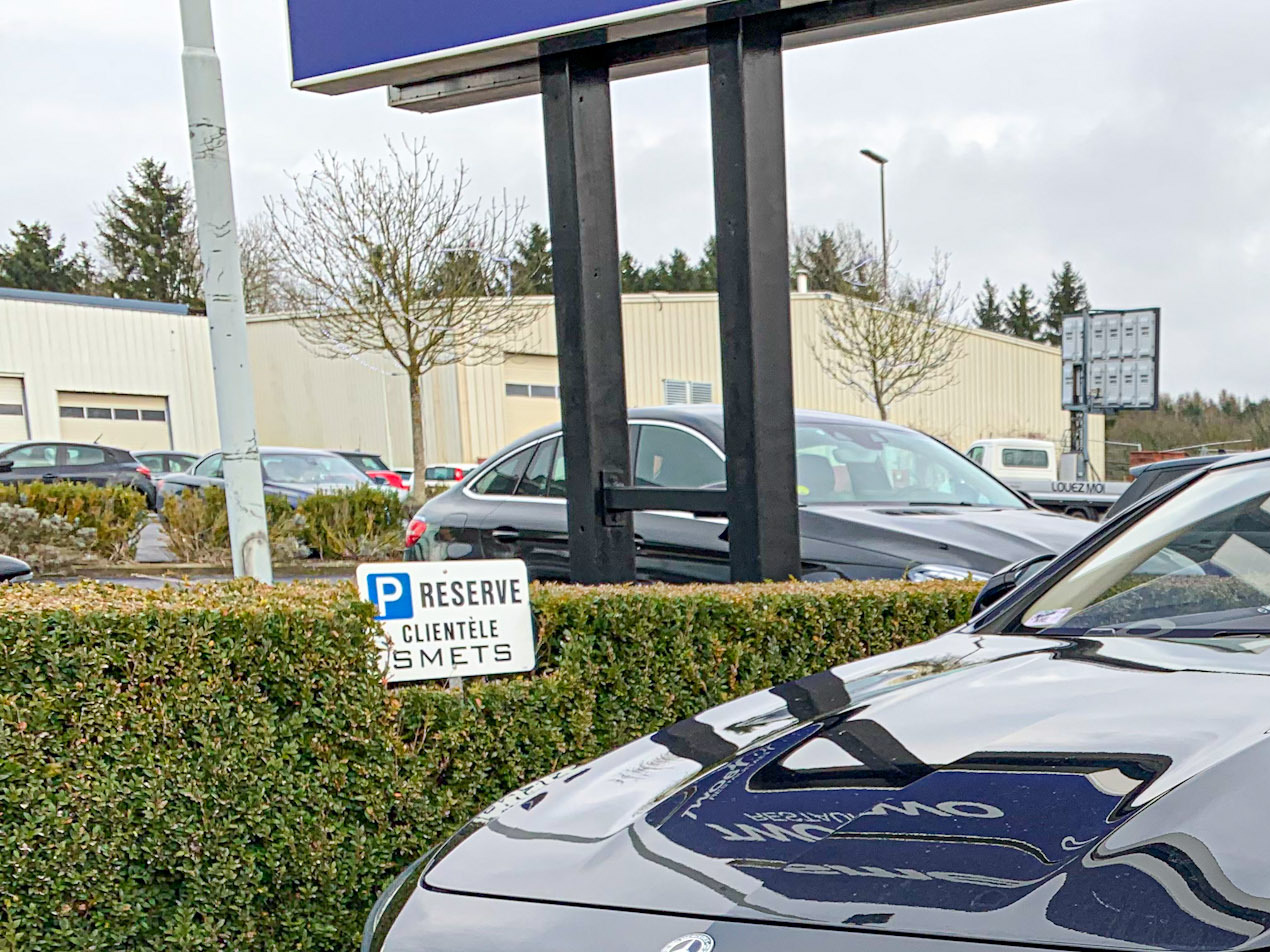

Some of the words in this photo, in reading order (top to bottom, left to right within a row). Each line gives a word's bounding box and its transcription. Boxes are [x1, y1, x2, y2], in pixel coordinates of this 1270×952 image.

[1052, 482, 1085, 493] LOUEZ
[1086, 483, 1106, 494] MOI
[376, 577, 403, 617] P
[420, 579, 522, 609] RESERVE
[402, 617, 499, 643] CLIENTÈLE
[393, 644, 512, 669] SMETS
